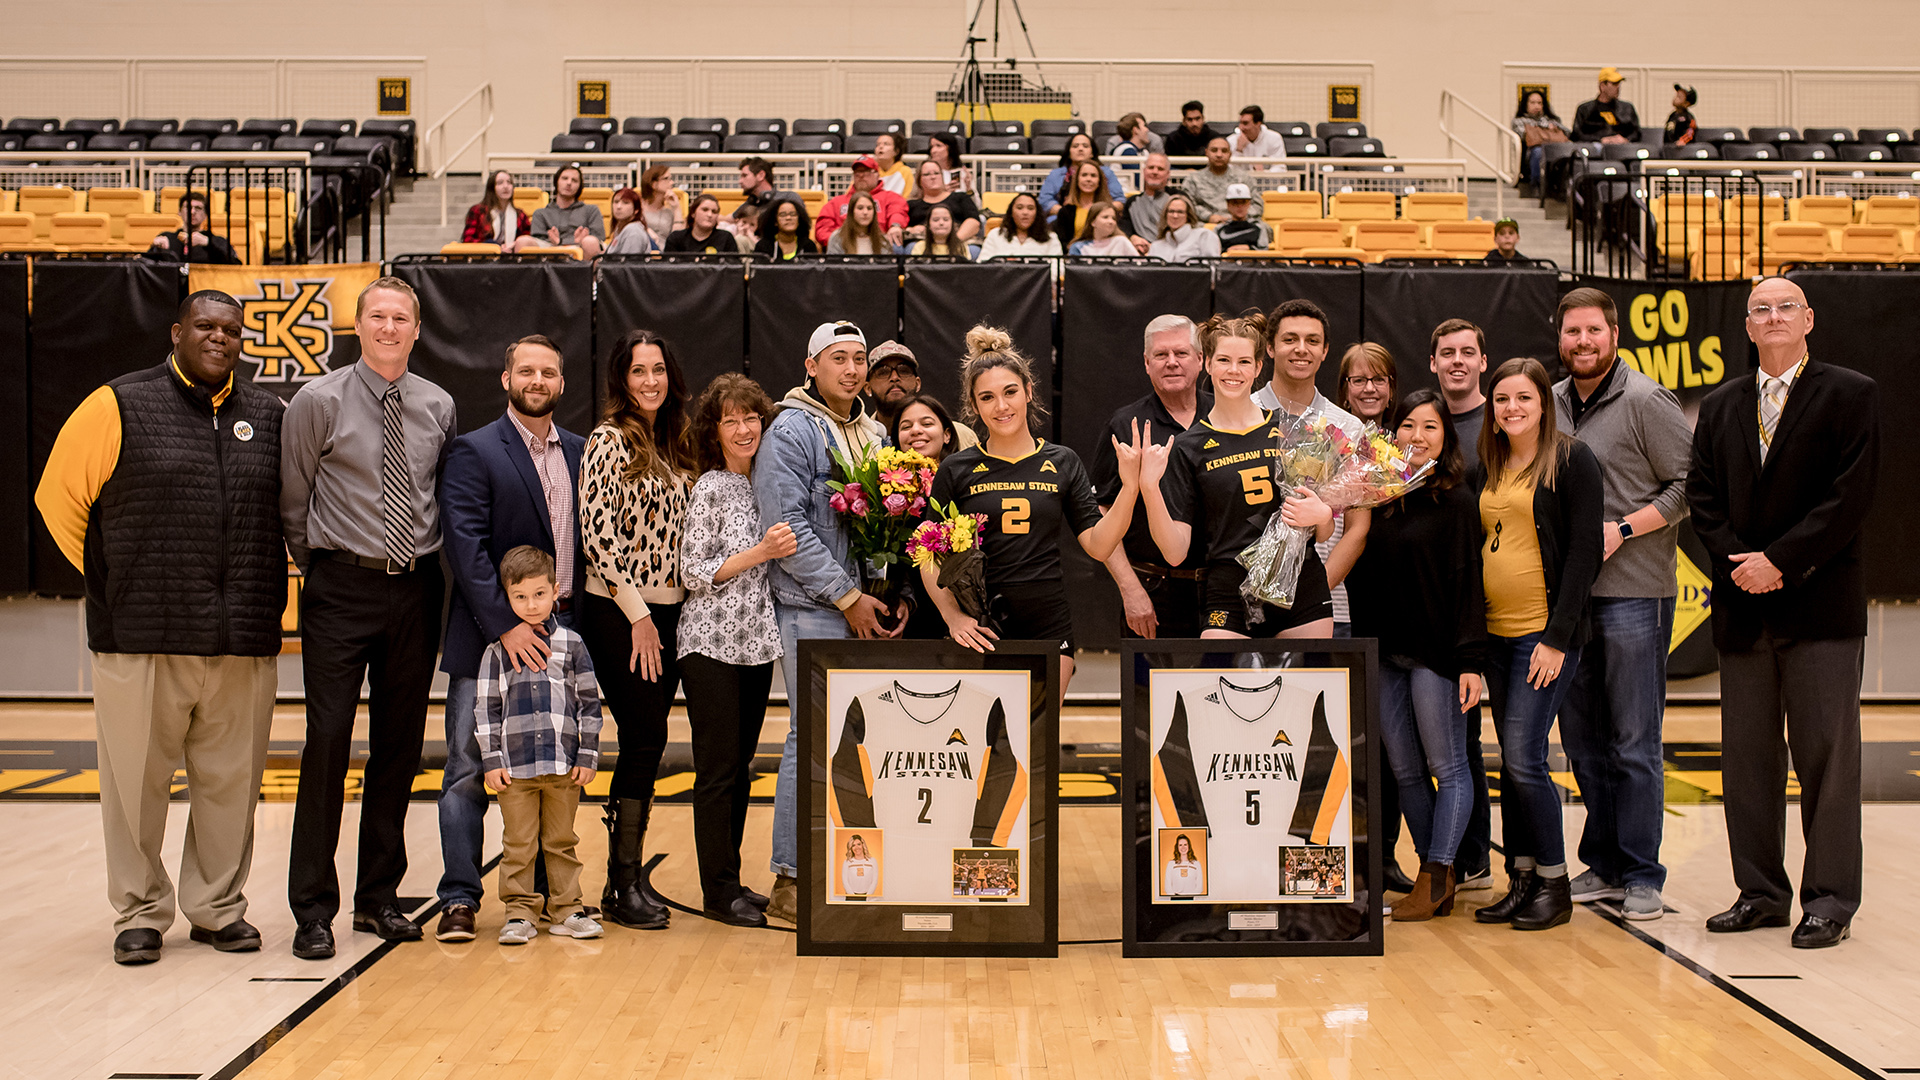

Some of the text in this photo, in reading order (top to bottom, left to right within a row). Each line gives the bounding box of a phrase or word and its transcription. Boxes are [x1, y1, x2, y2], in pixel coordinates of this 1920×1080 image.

[384, 86, 404, 98] 110
[1630, 289, 1689, 342] GO
[1206, 450, 1261, 471] KENNESAW
[970, 481, 1059, 495] KENNESAW STATE
[1237, 465, 1273, 505] 5
[1001, 497, 1031, 535] 2
[878, 751, 973, 781] KENNESAW
[896, 770, 956, 779] STATE
[1206, 753, 1298, 783] KENNESAW
[1223, 773, 1281, 781] STATE
[917, 787, 932, 824] 2
[1245, 789, 1260, 826] 5
